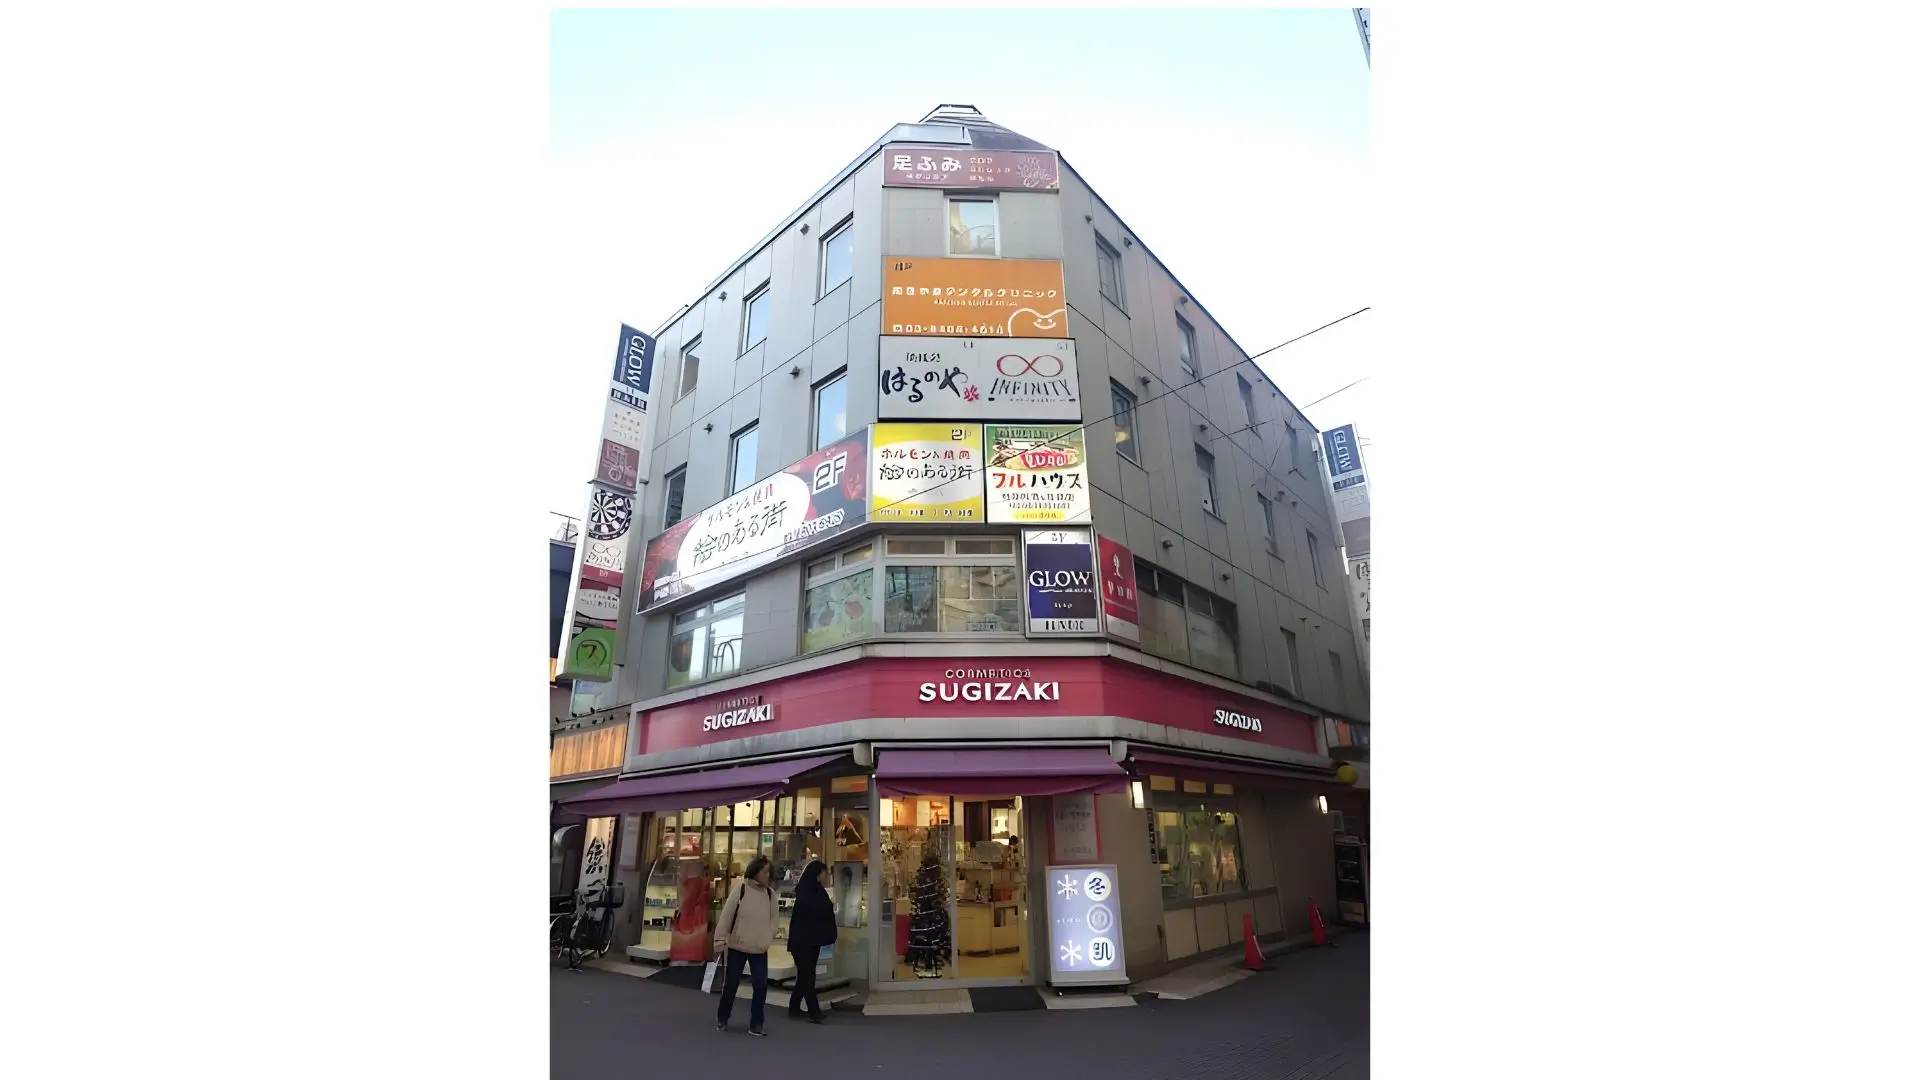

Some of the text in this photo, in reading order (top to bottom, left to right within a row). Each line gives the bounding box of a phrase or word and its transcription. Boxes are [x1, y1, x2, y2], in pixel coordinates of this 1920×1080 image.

[892, 154, 962, 171] 足ふみ
[627, 335, 646, 387] GLOW
[881, 366, 969, 403] はるのや
[990, 378, 1072, 396] INFINITY
[814, 452, 847, 494] 2F
[992, 472, 1083, 489] フルハウス
[1029, 570, 1093, 588] GLOW
[918, 681, 1060, 702] SUGIZAKI
[703, 703, 773, 732] SUGIZAKI
